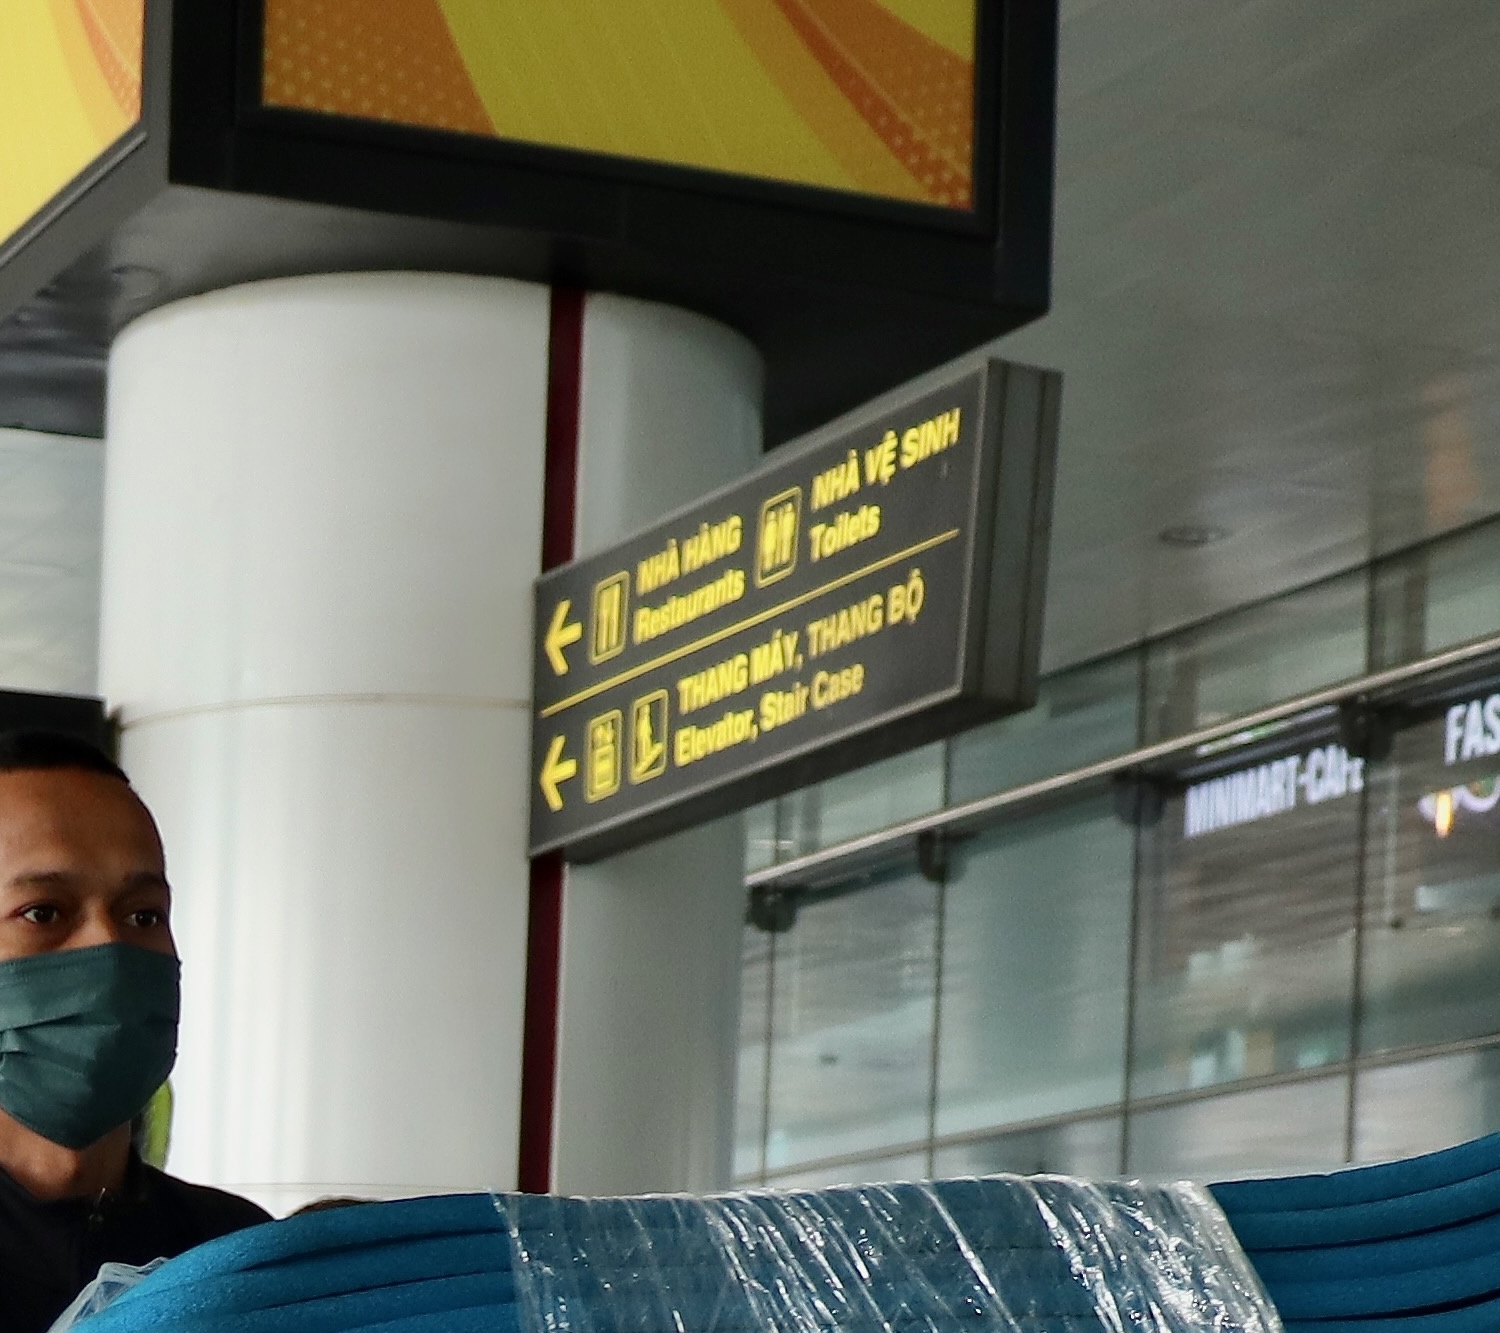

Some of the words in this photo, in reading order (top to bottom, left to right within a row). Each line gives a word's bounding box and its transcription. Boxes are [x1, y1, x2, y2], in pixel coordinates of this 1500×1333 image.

[811, 447, 862, 512] NHÀ
[864, 428, 898, 486] VỆ
[900, 407, 961, 469] SINH
[636, 538, 682, 596] NHÀ
[681, 514, 744, 575] HÀNG
[809, 503, 881, 563] Toilets
[633, 567, 746, 645] Restaurants
[677, 653, 751, 715] THANG
[805, 593, 884, 658] THANG
[886, 567, 925, 627] BỘ
[674, 707, 759, 778] Elevator,
[759, 681, 809, 732] Stair
[810, 662, 866, 712] Case
